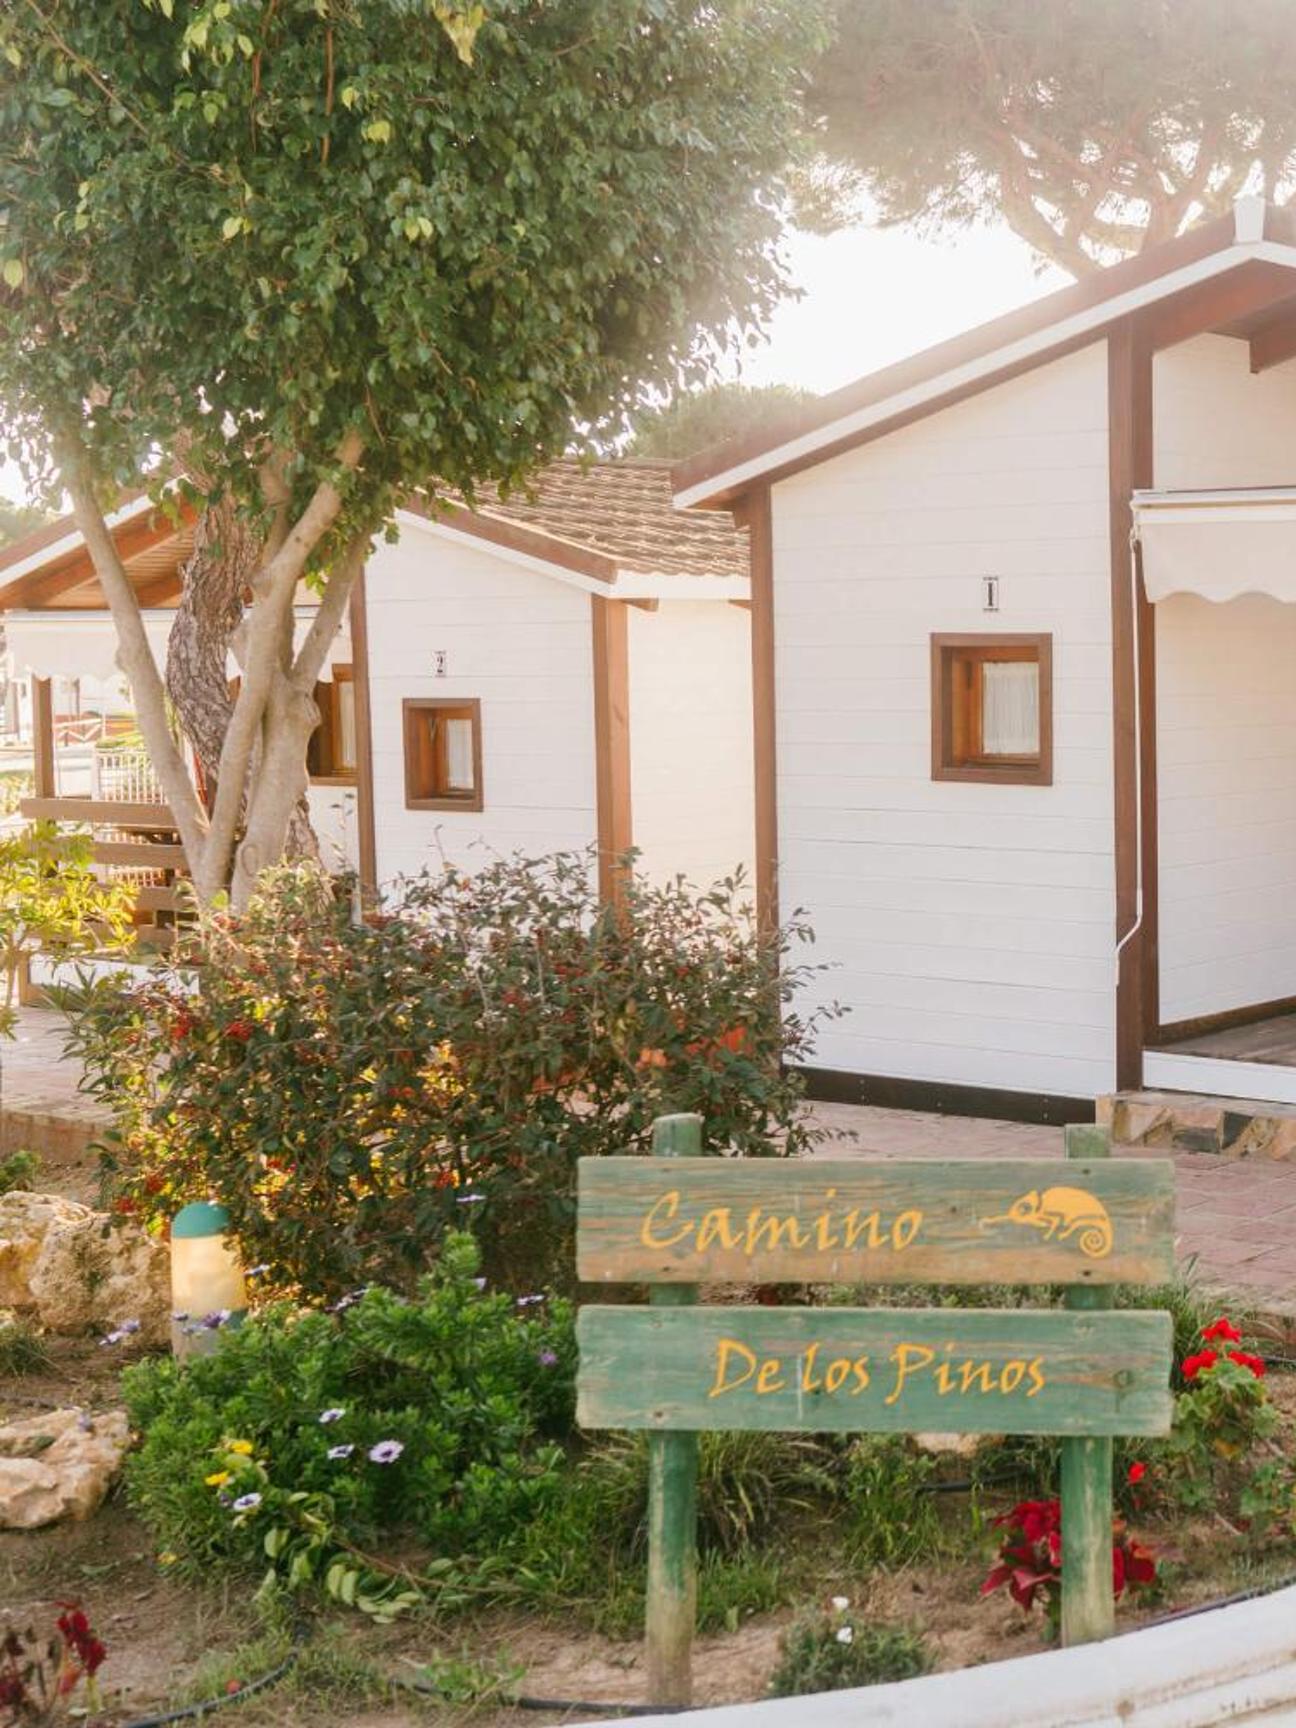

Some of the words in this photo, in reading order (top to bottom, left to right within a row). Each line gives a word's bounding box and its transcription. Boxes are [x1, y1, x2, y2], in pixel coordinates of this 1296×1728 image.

[639, 1187, 924, 1256] Camino
[708, 1338, 784, 1399] De
[801, 1341, 870, 1397] los
[885, 1341, 1047, 1406] Pinos
